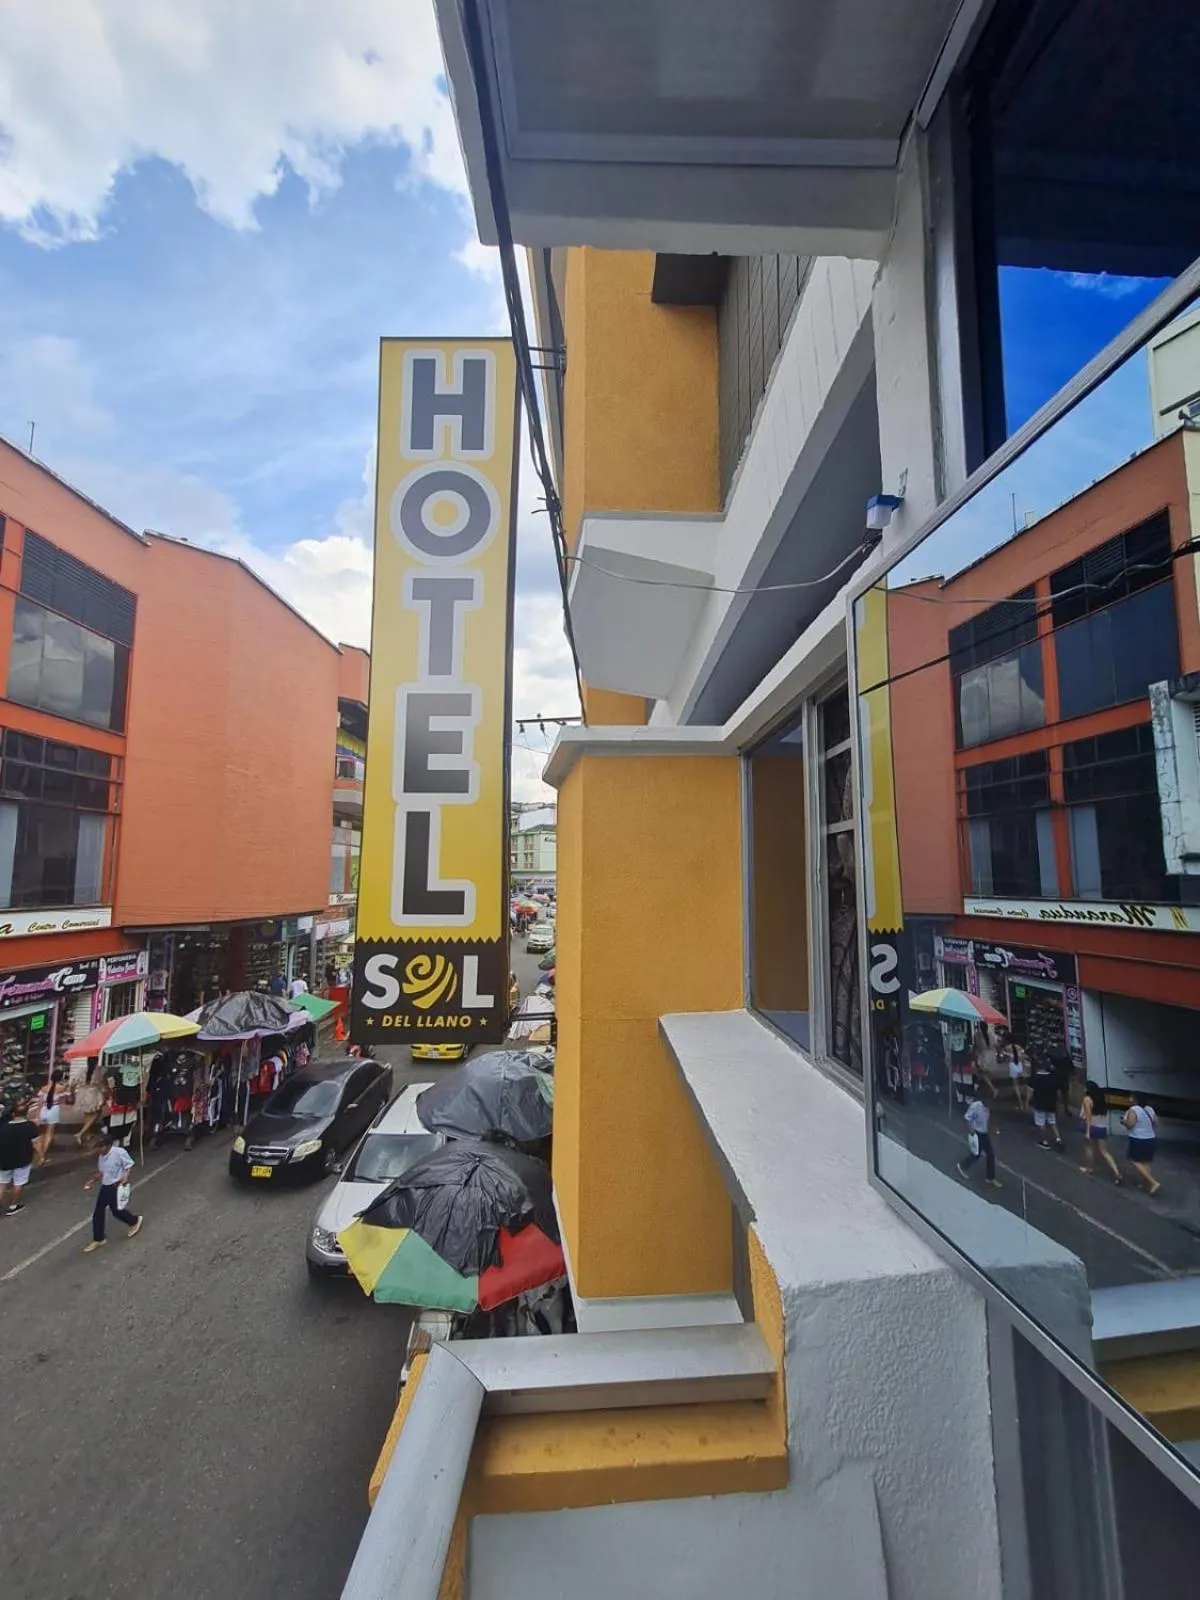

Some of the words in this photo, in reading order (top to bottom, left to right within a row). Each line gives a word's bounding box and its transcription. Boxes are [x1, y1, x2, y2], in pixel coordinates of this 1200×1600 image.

[398, 355, 493, 917] HOTEL
[27, 921, 57, 933] Centro
[61, 919, 101, 930] Comercial
[361, 953, 495, 1009] SOL
[382, 1015, 412, 1028] DEL
[416, 1015, 472, 1028] LLANO
